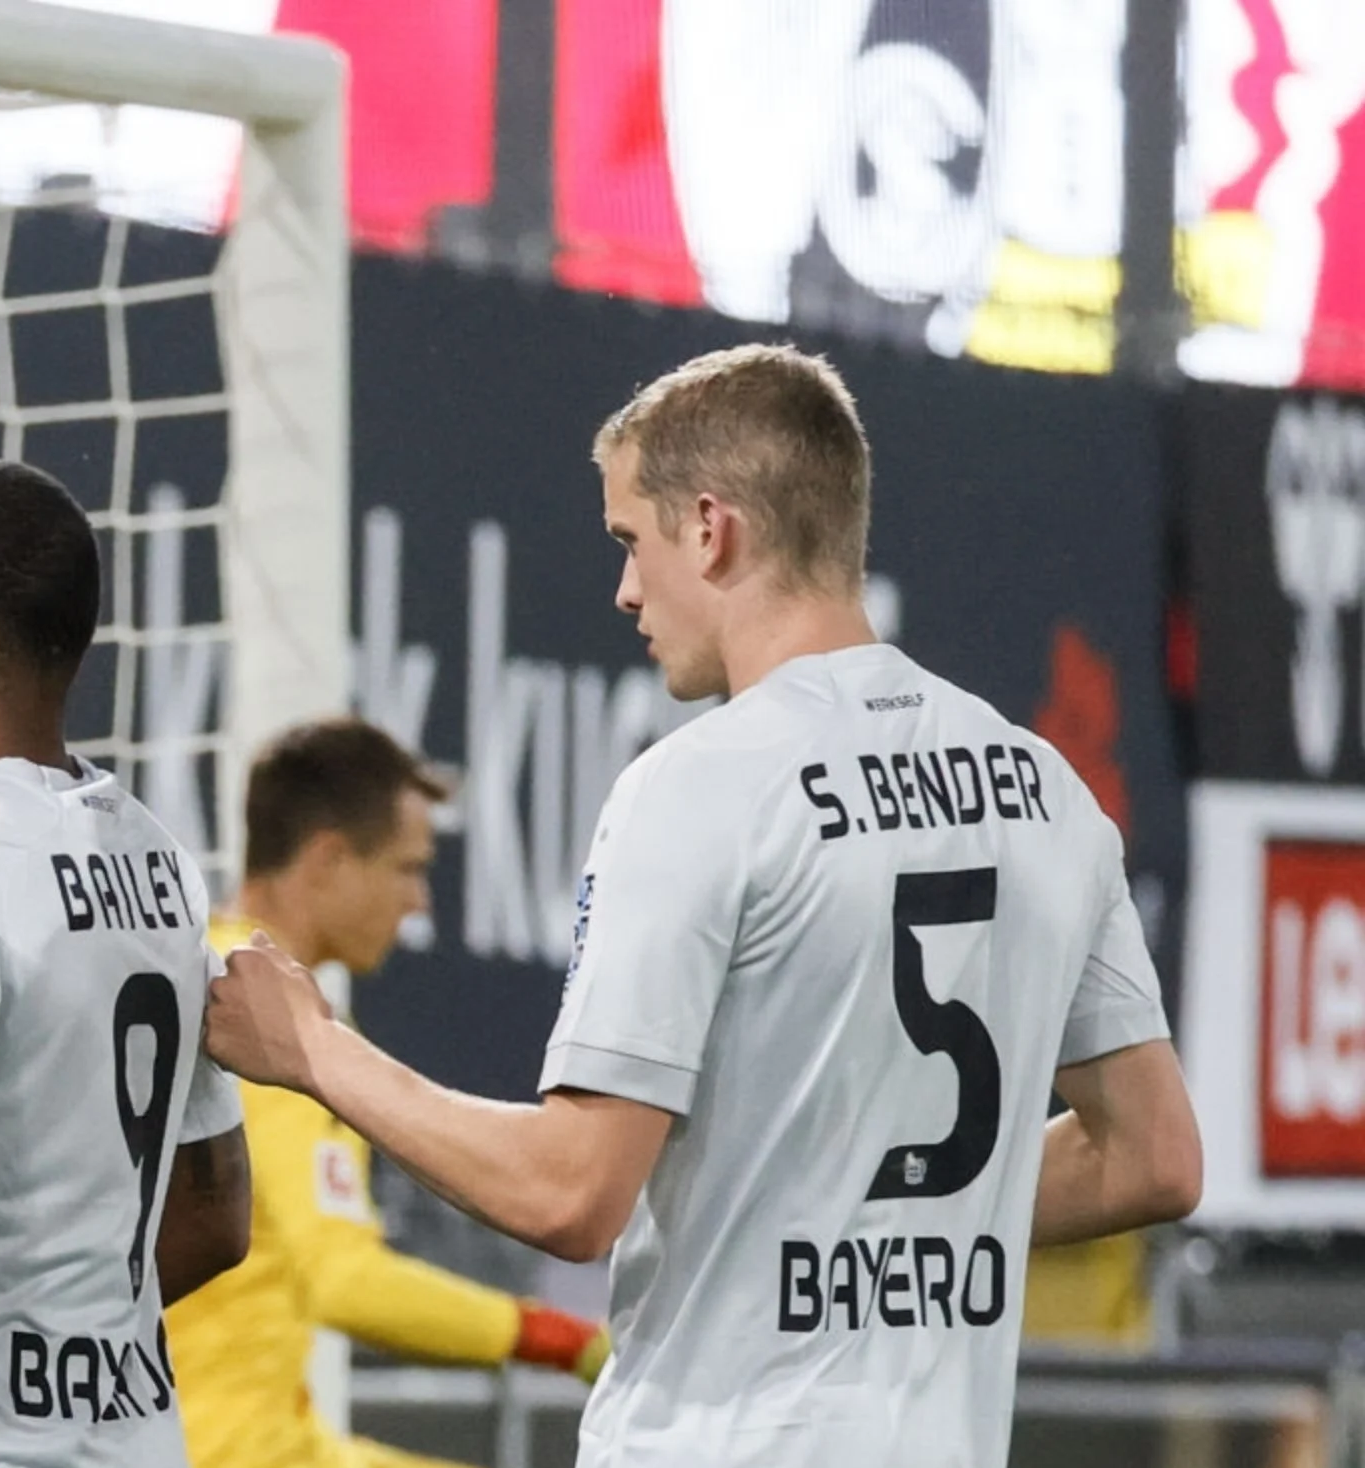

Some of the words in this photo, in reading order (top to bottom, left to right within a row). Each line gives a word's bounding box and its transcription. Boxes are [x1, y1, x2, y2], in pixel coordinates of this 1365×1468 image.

[51, 850, 194, 932] BAILEY
[865, 866, 1001, 1201] 5
[112, 972, 180, 1303] 9
